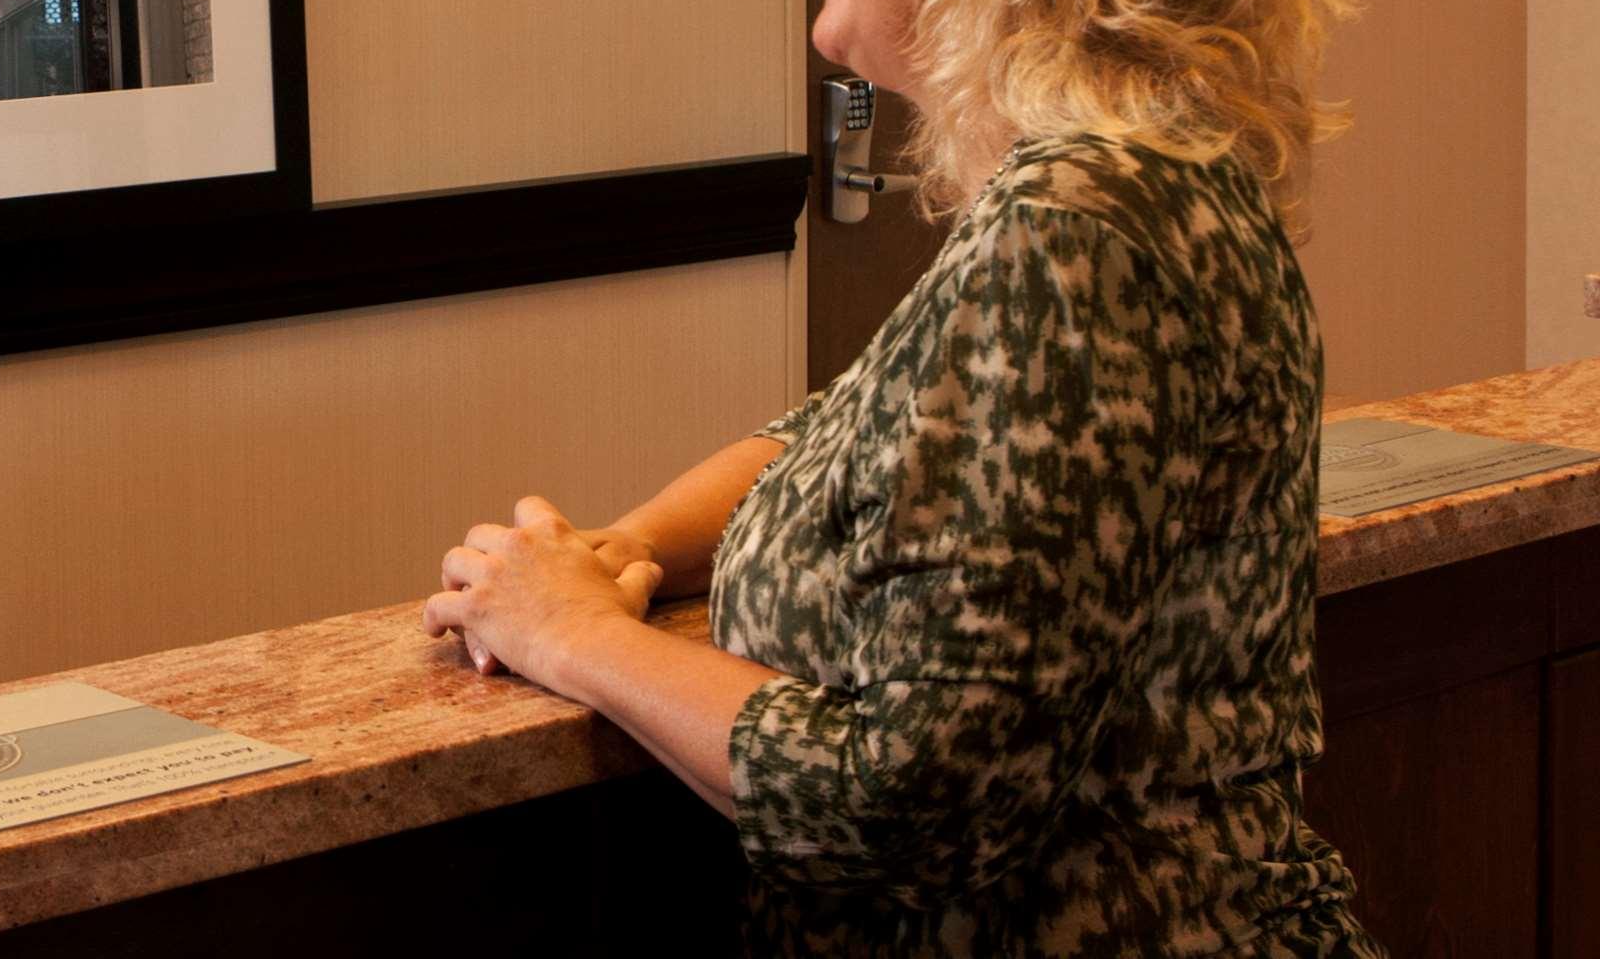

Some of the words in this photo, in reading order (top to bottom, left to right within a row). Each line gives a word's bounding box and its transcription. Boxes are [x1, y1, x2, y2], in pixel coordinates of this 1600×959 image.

[2, 796, 32, 805] we
[36, 782, 89, 797] don't
[92, 768, 154, 785] expect
[157, 759, 192, 771] you
[220, 746, 254, 758] pay.
